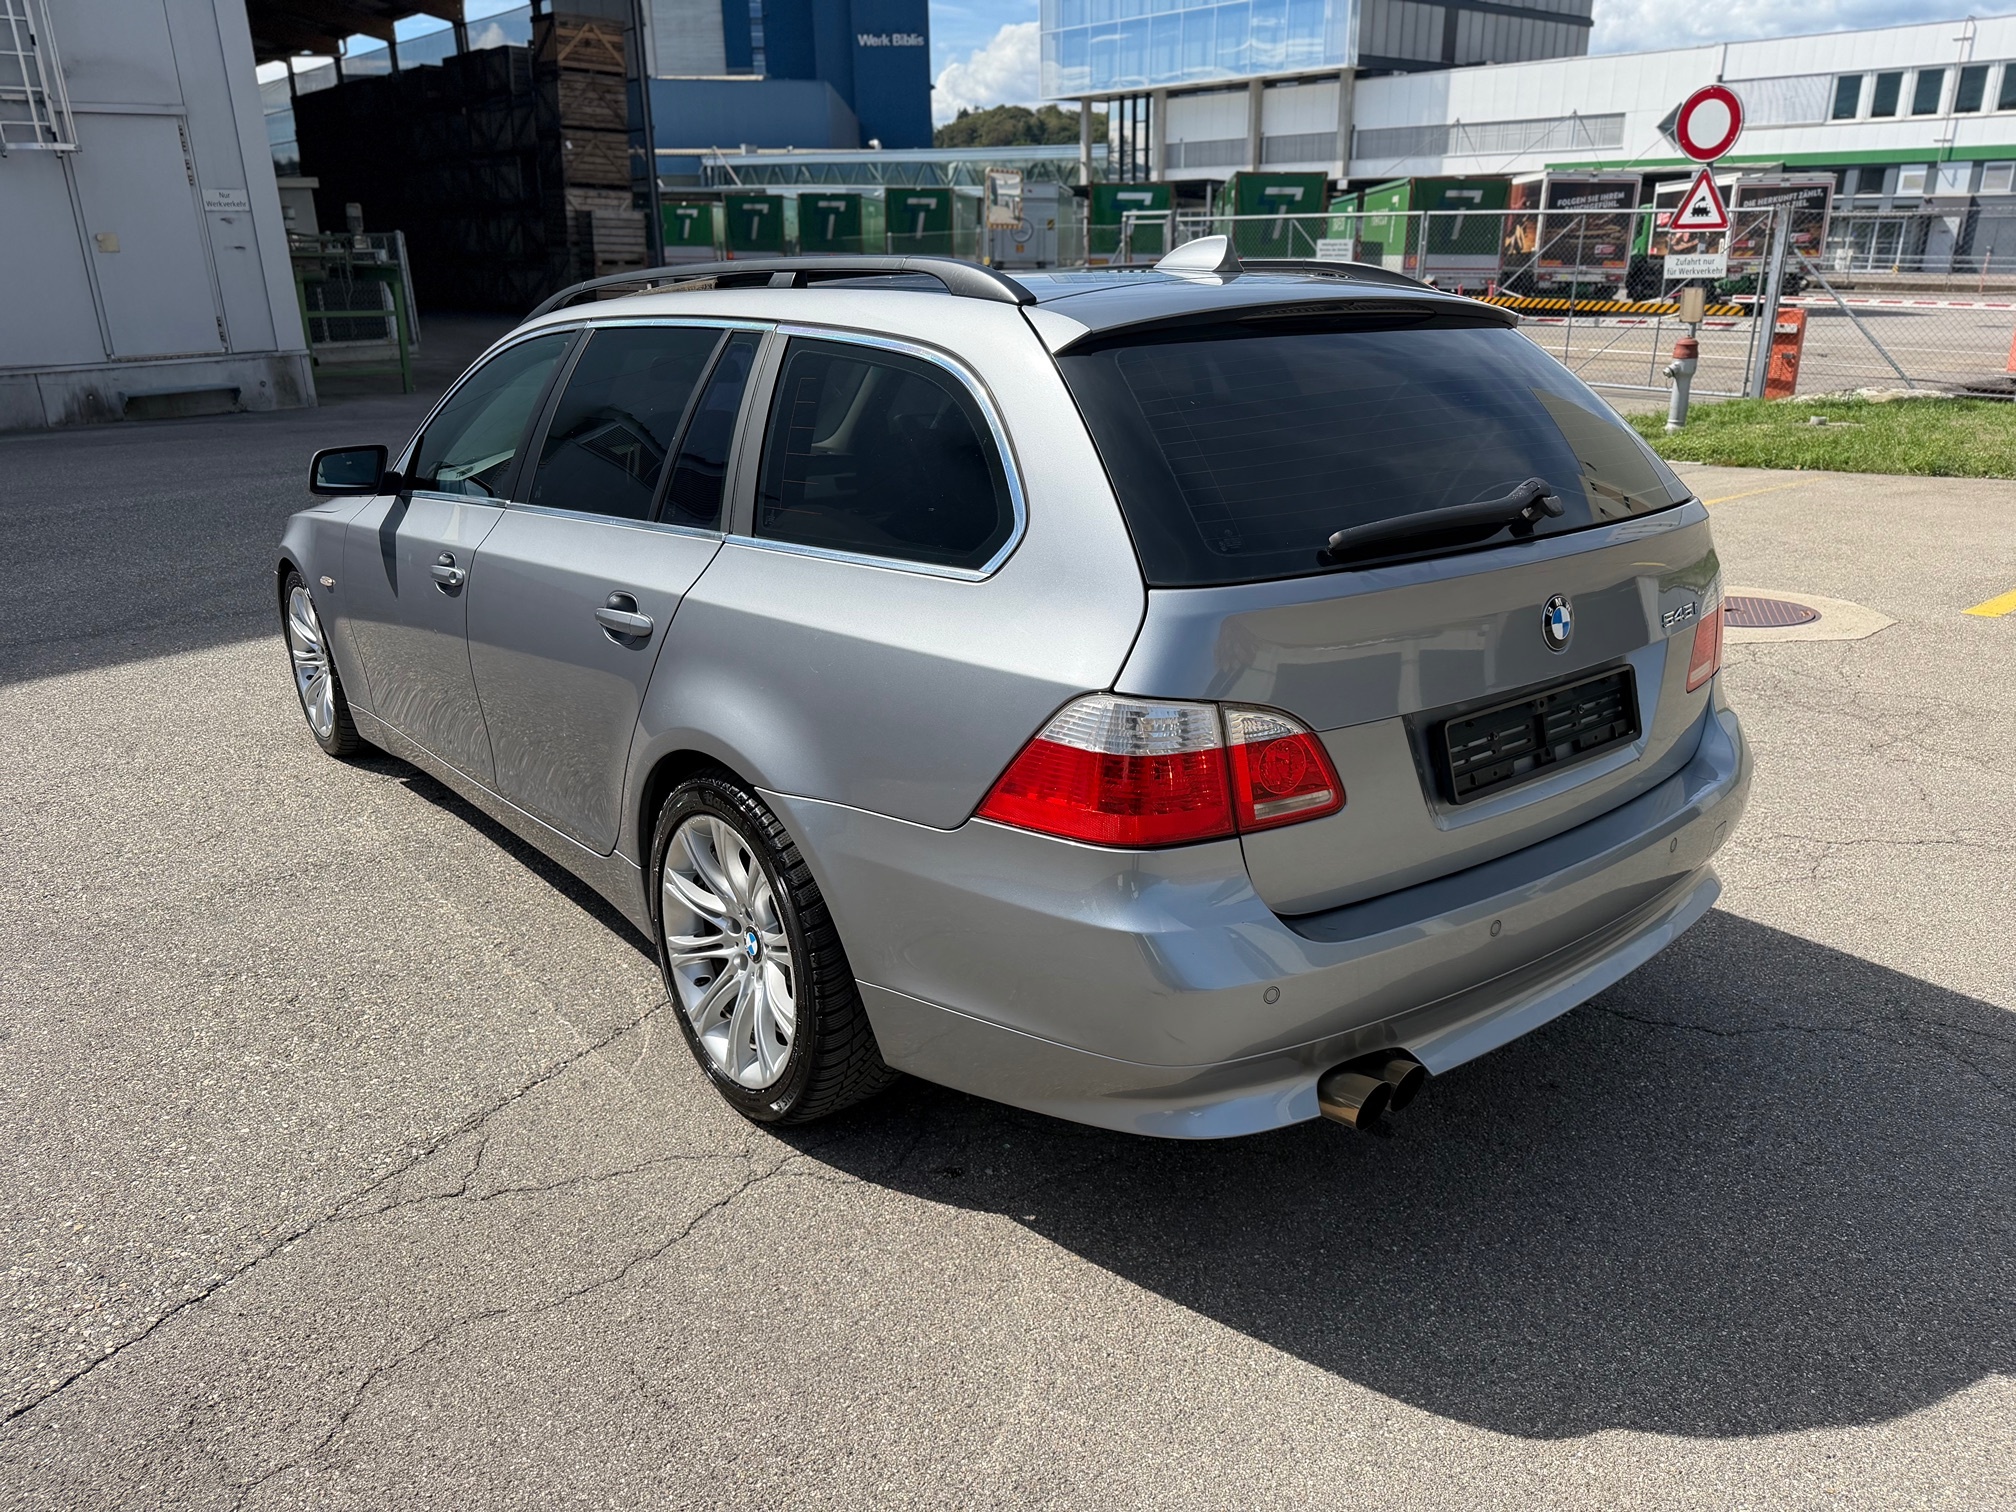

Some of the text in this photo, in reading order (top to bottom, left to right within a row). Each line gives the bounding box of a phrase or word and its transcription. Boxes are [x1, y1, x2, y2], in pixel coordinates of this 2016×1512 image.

[857, 33, 925, 47] Werk Biblis
[218, 191, 231, 199] Nur
[1557, 191, 1626, 207] FOLGEN SIE IHREM
[1743, 188, 1824, 208] DIE HERKUNFT ZÄHLT,
[205, 200, 247, 208] Werkverkehr
[1675, 257, 1702, 266] Zufahrt
[1666, 266, 1724, 276] für Werkverkehr
